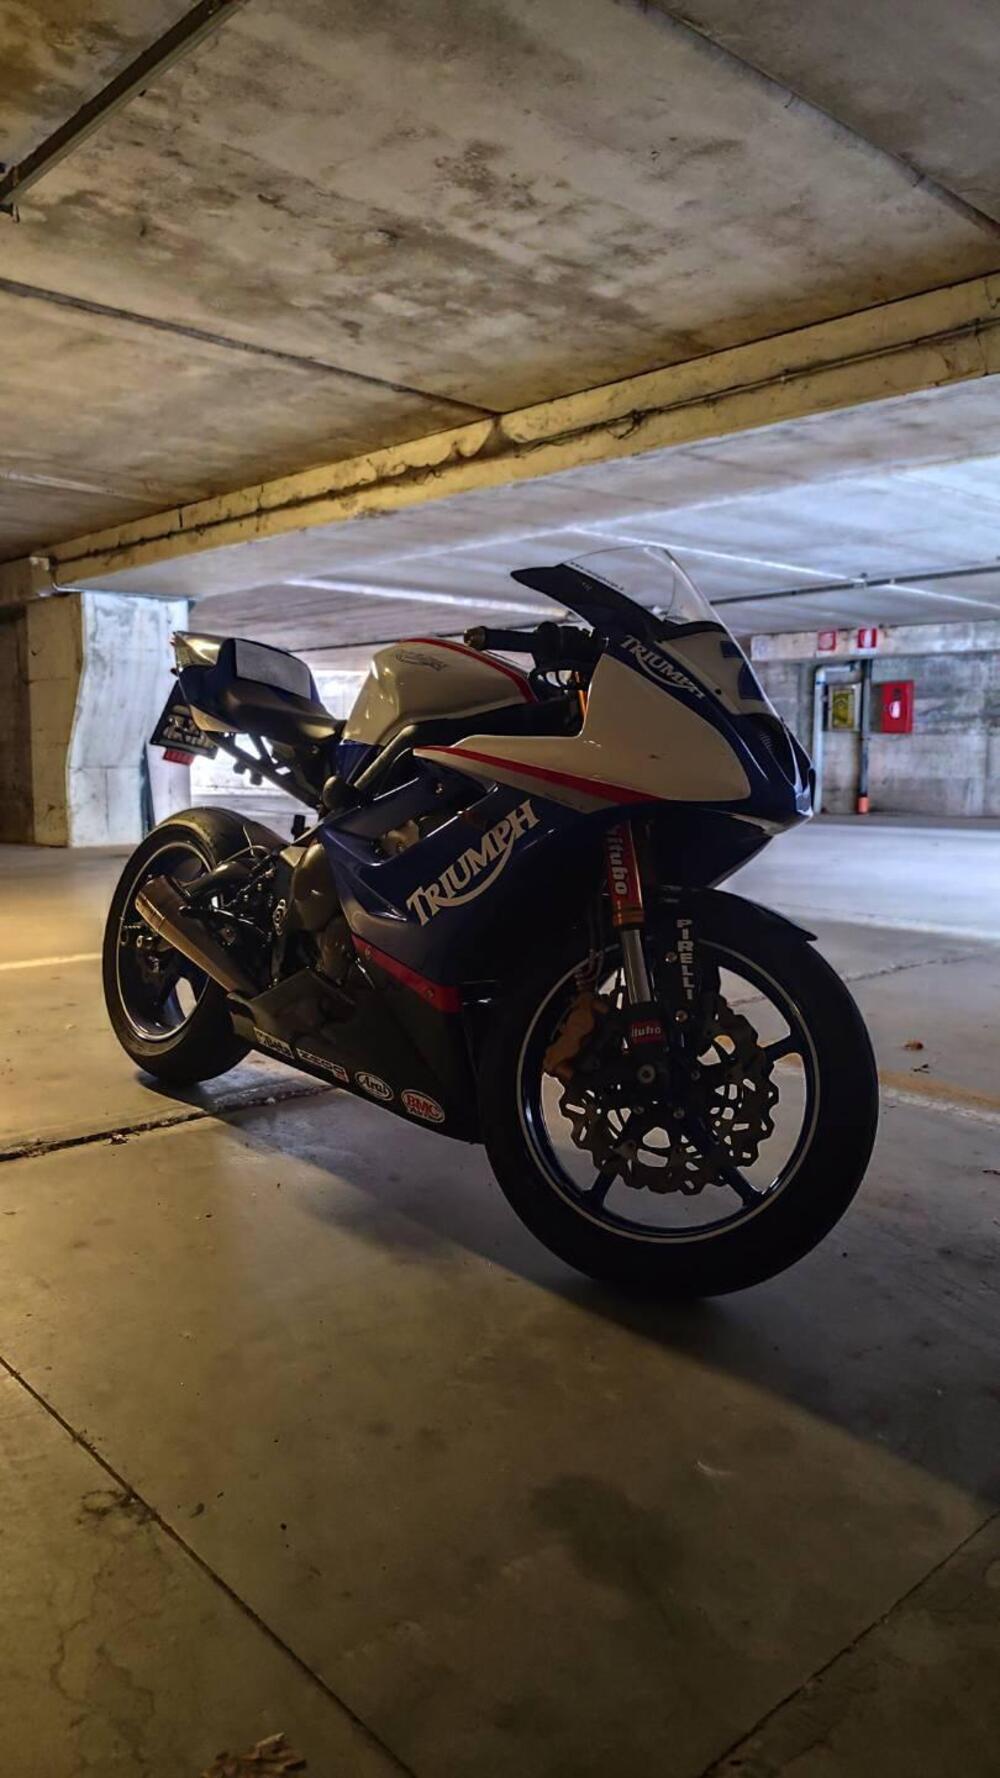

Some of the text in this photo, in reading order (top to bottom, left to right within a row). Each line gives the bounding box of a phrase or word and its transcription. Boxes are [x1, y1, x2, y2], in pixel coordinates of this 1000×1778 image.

[620, 634, 706, 699] TRIUMPH
[406, 800, 540, 926] TRIUMPH
[676, 919, 695, 1000] PIRELLI
[360, 1076, 389, 1095] Arai
[407, 1094, 440, 1118] BMC
